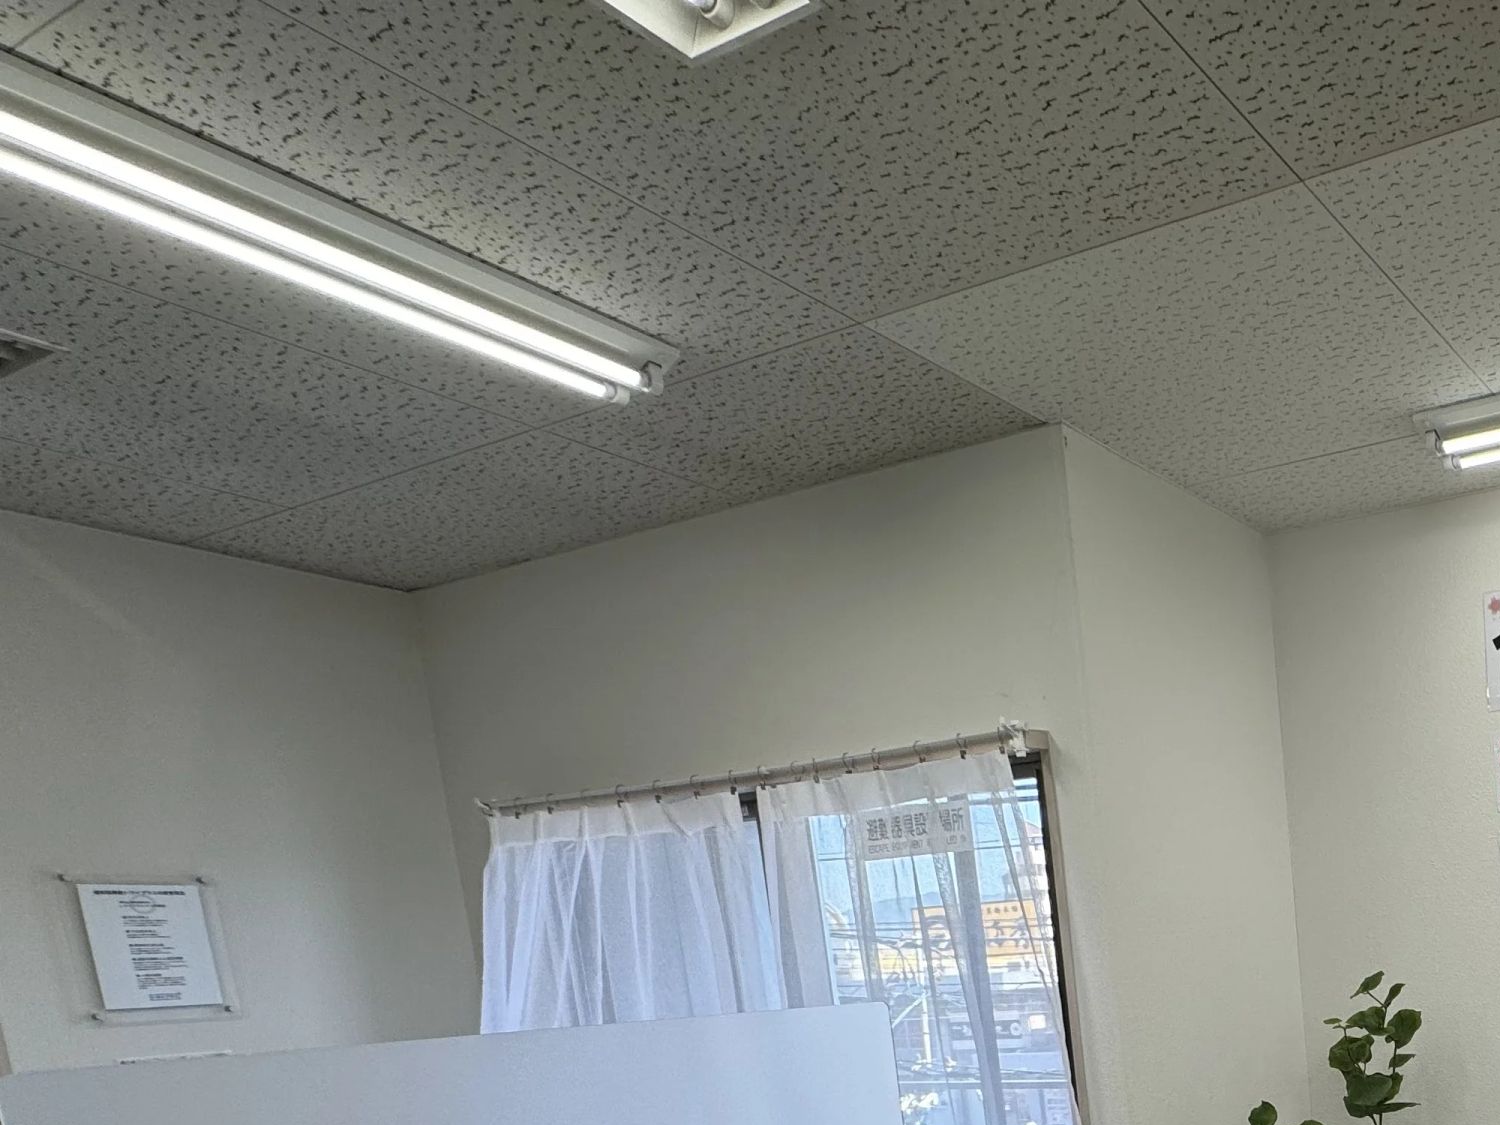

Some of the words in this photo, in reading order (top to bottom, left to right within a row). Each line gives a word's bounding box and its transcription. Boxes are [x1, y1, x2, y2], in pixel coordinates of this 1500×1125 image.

[866, 808, 964, 841] 避難器具設場所
